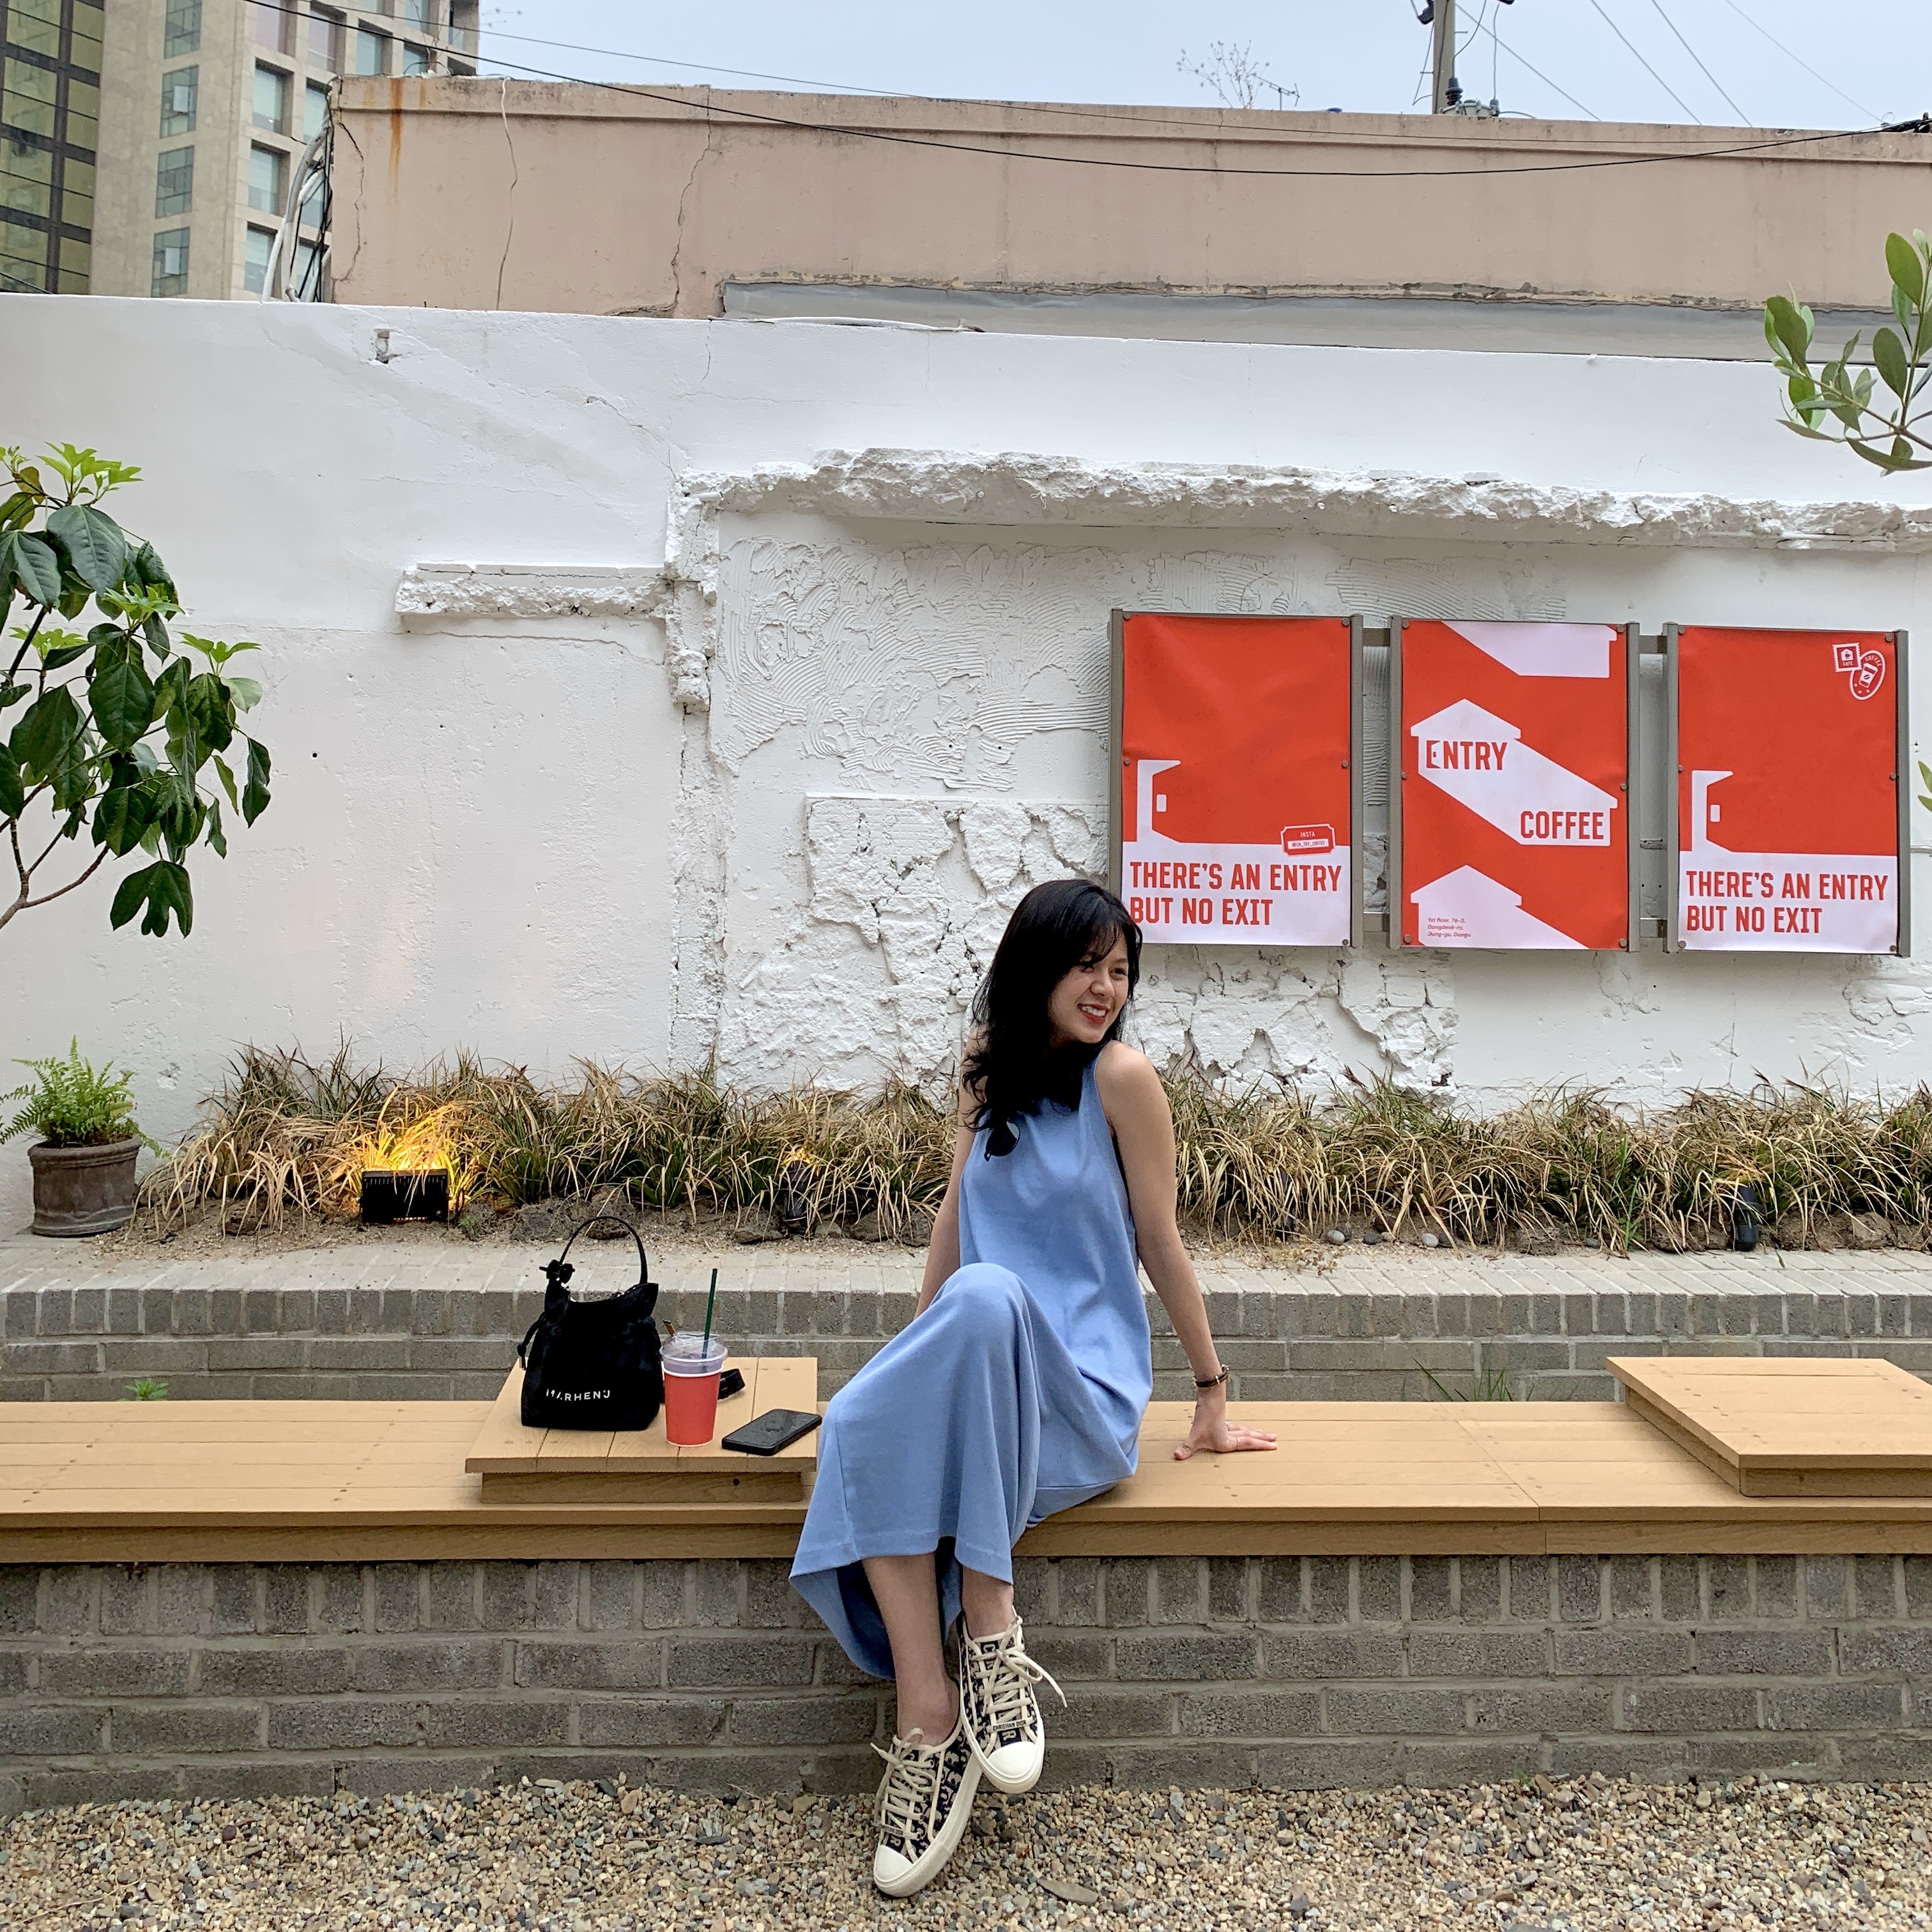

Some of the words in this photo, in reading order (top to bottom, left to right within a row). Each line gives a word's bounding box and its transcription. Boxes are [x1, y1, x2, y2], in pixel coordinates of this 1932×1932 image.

[1426, 740, 1508, 770] ENTRY
[1521, 811, 1604, 839] COFFEE
[1130, 862, 1222, 889] THERE'S
[1230, 864, 1260, 890] AN
[1270, 864, 1342, 891] ENTRY
[1686, 871, 1774, 898] THERE'S
[1782, 873, 1810, 899] AN
[1820, 874, 1888, 901] ENTRY
[1130, 897, 1174, 924] BUT
[1183, 898, 1213, 924] NO
[1222, 899, 1273, 925] EXIT
[1687, 905, 1727, 931] BUT
[1736, 906, 1765, 932] NO
[1774, 907, 1822, 933] EXIT
